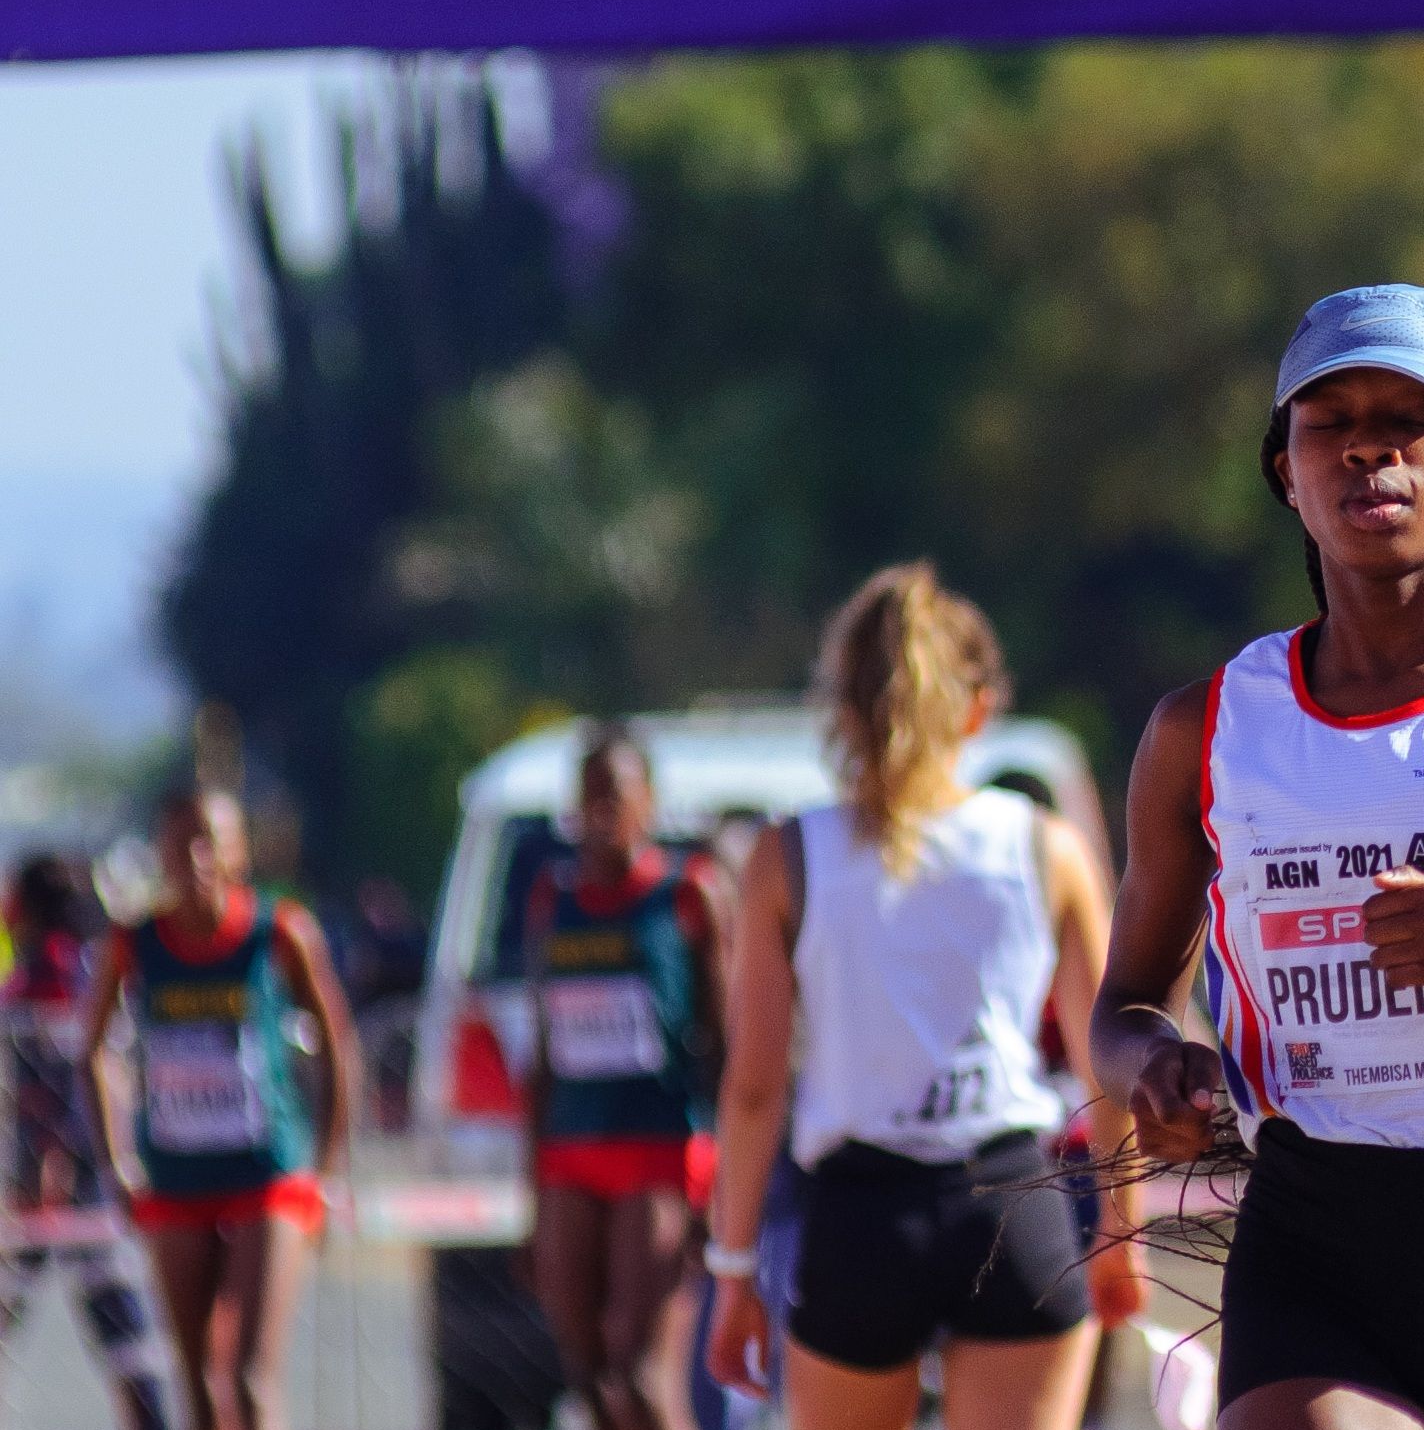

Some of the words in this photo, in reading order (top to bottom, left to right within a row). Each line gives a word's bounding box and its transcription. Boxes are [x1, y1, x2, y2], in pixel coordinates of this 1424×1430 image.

[1265, 860, 1320, 889] AGN
[1336, 844, 1393, 879] 2021
[1298, 912, 1360, 942] SP
[1344, 1064, 1412, 1086] THEMBISA
